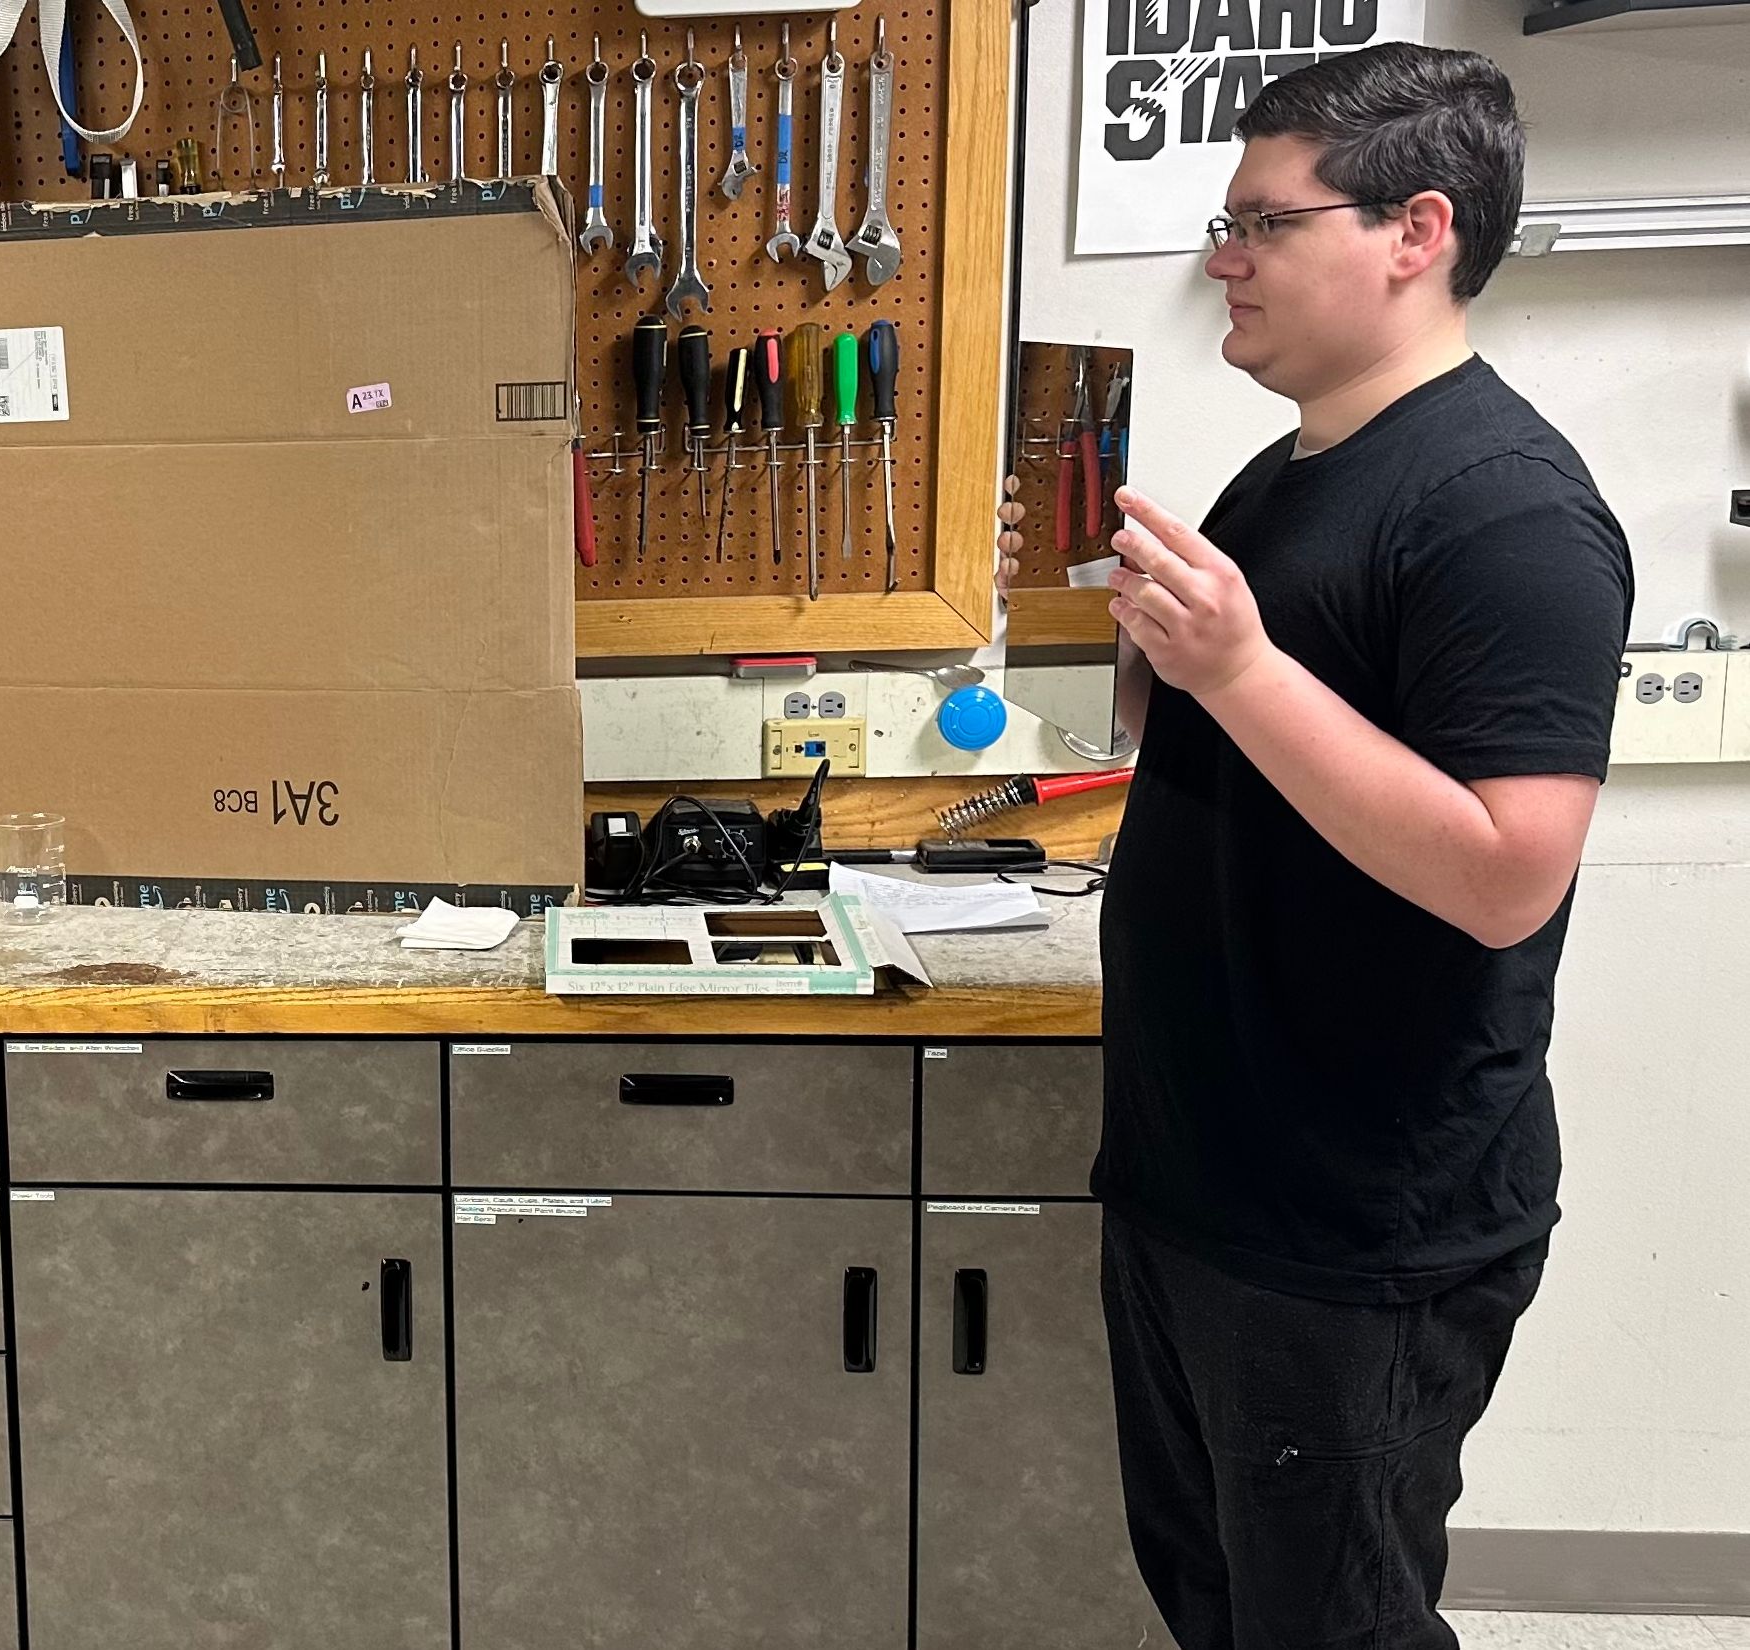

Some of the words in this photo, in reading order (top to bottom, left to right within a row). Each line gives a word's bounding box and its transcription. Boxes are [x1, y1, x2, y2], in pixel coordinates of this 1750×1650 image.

[1106, 0, 1377, 55] IDAHO
[1104, 52, 1362, 161] STA
[352, 393, 363, 409] A
[213, 789, 258, 814] BC8
[272, 780, 339, 826] 3A1
[568, 980, 585, 992] Six
[638, 980, 665, 992] Plain
[669, 981, 696, 994] Edge
[699, 981, 740, 993] Mirror
[744, 982, 770, 993] Tiles
